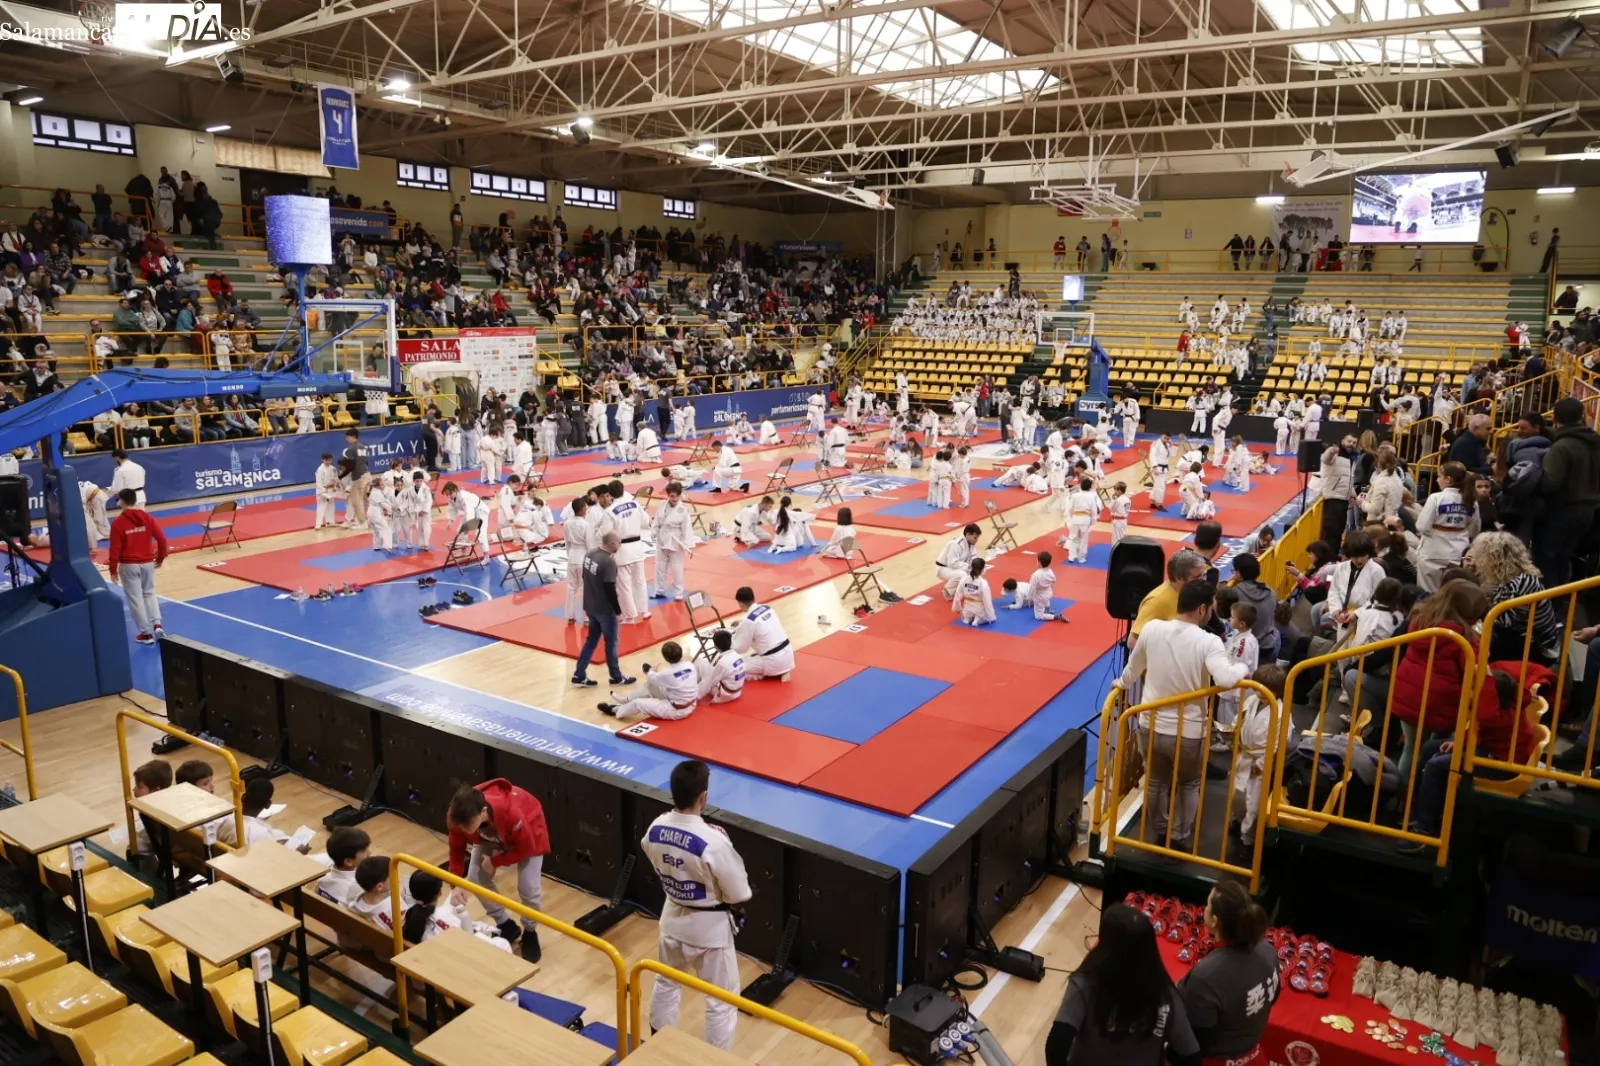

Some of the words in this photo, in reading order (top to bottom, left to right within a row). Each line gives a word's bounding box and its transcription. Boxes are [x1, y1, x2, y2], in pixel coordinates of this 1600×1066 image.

[332, 109, 343, 134] 4
[404, 352, 457, 362] PATRIMONIO
[410, 439, 419, 454] Y
[195, 469, 222, 478] turismo
[630, 725, 649, 734] 18
[659, 828, 693, 848] CHARLIE
[662, 853, 685, 869] ESP
[1506, 903, 1598, 944] molten
